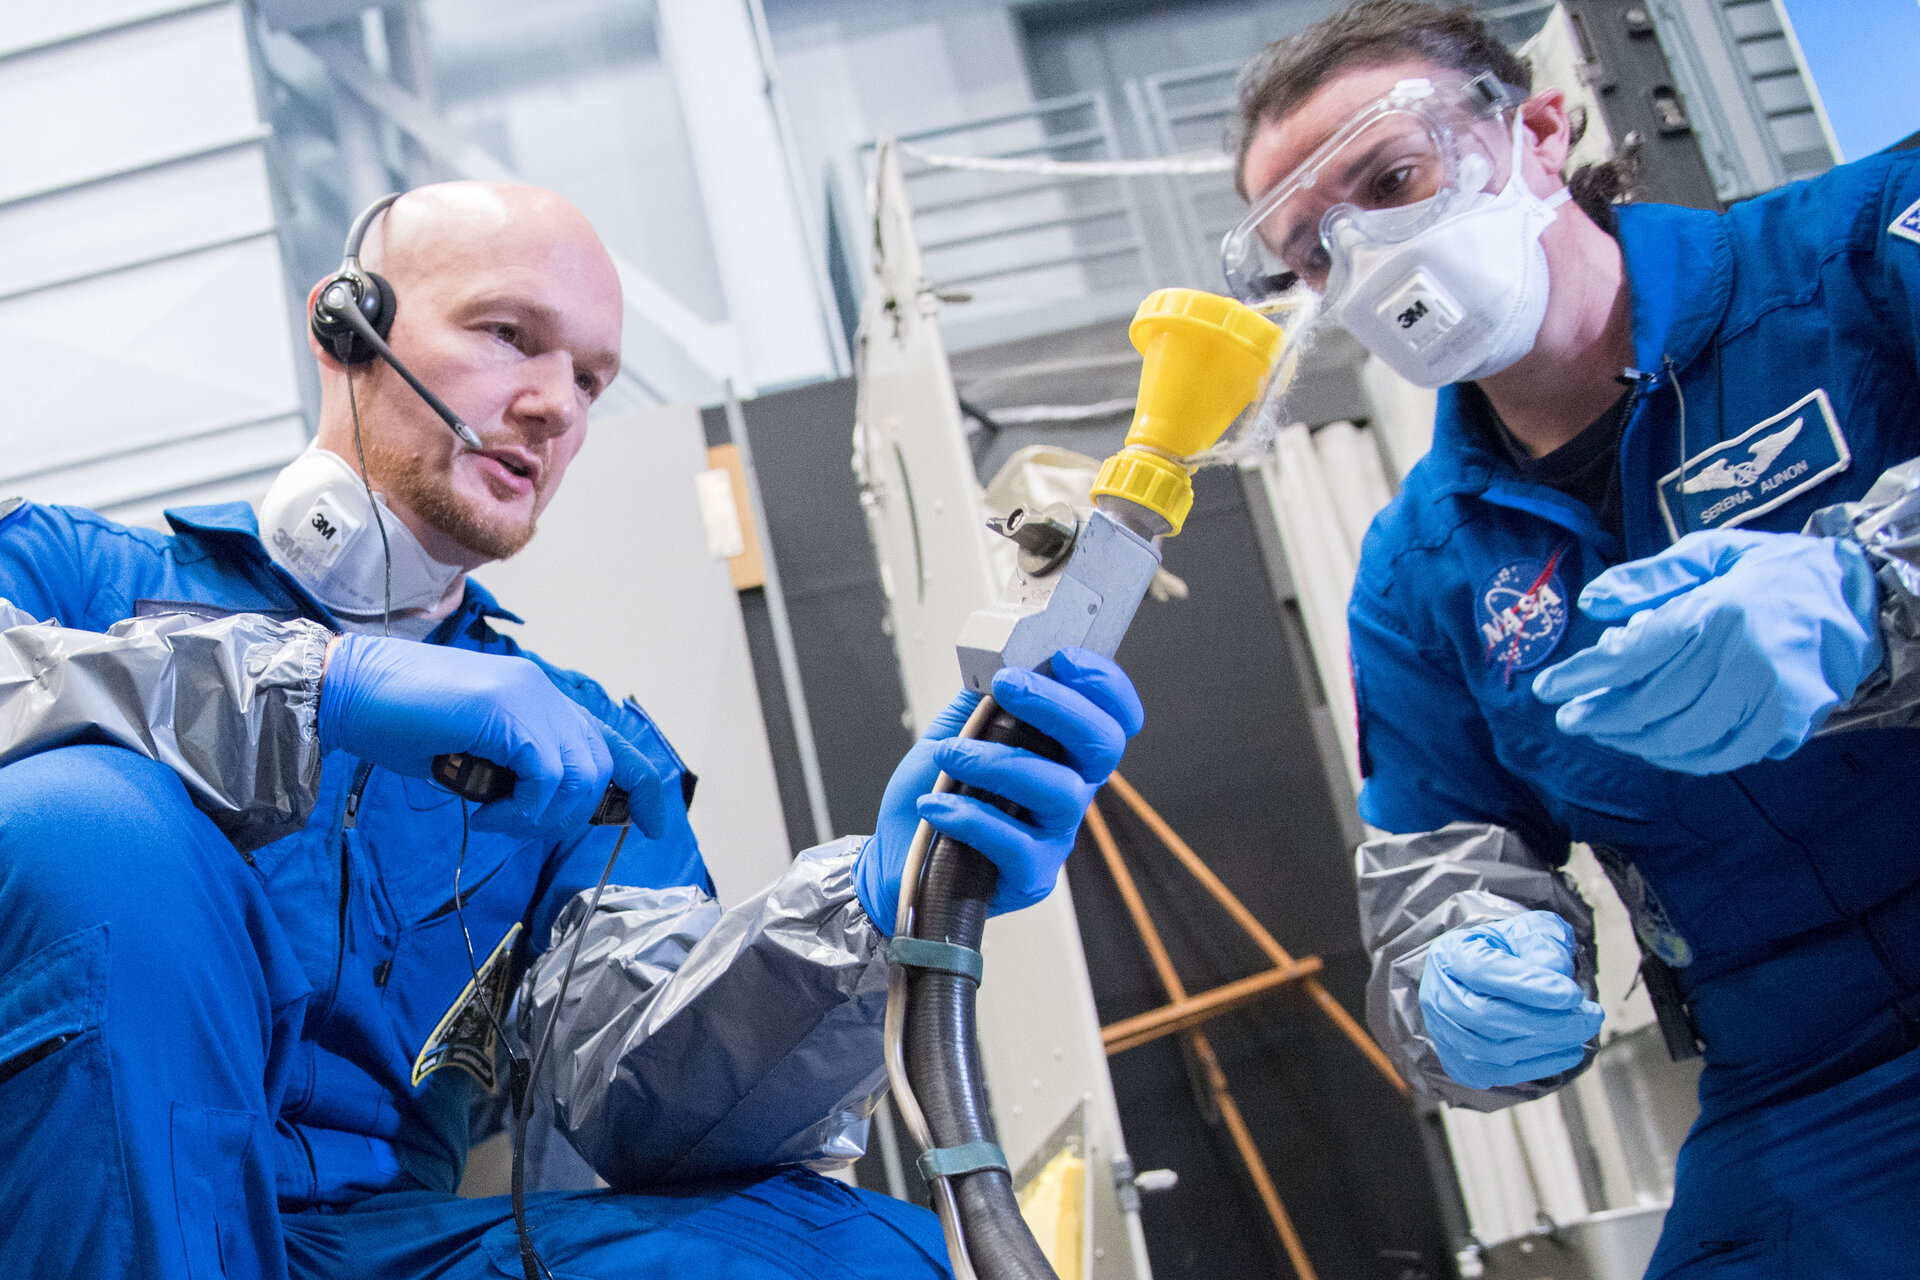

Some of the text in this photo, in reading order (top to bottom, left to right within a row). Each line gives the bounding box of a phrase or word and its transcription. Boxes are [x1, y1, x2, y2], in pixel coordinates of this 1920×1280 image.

[1397, 300, 1429, 329] 3M
[1700, 489, 1753, 525] SERENA
[311, 513, 337, 540] 3M
[1482, 583, 1562, 648] NASA
